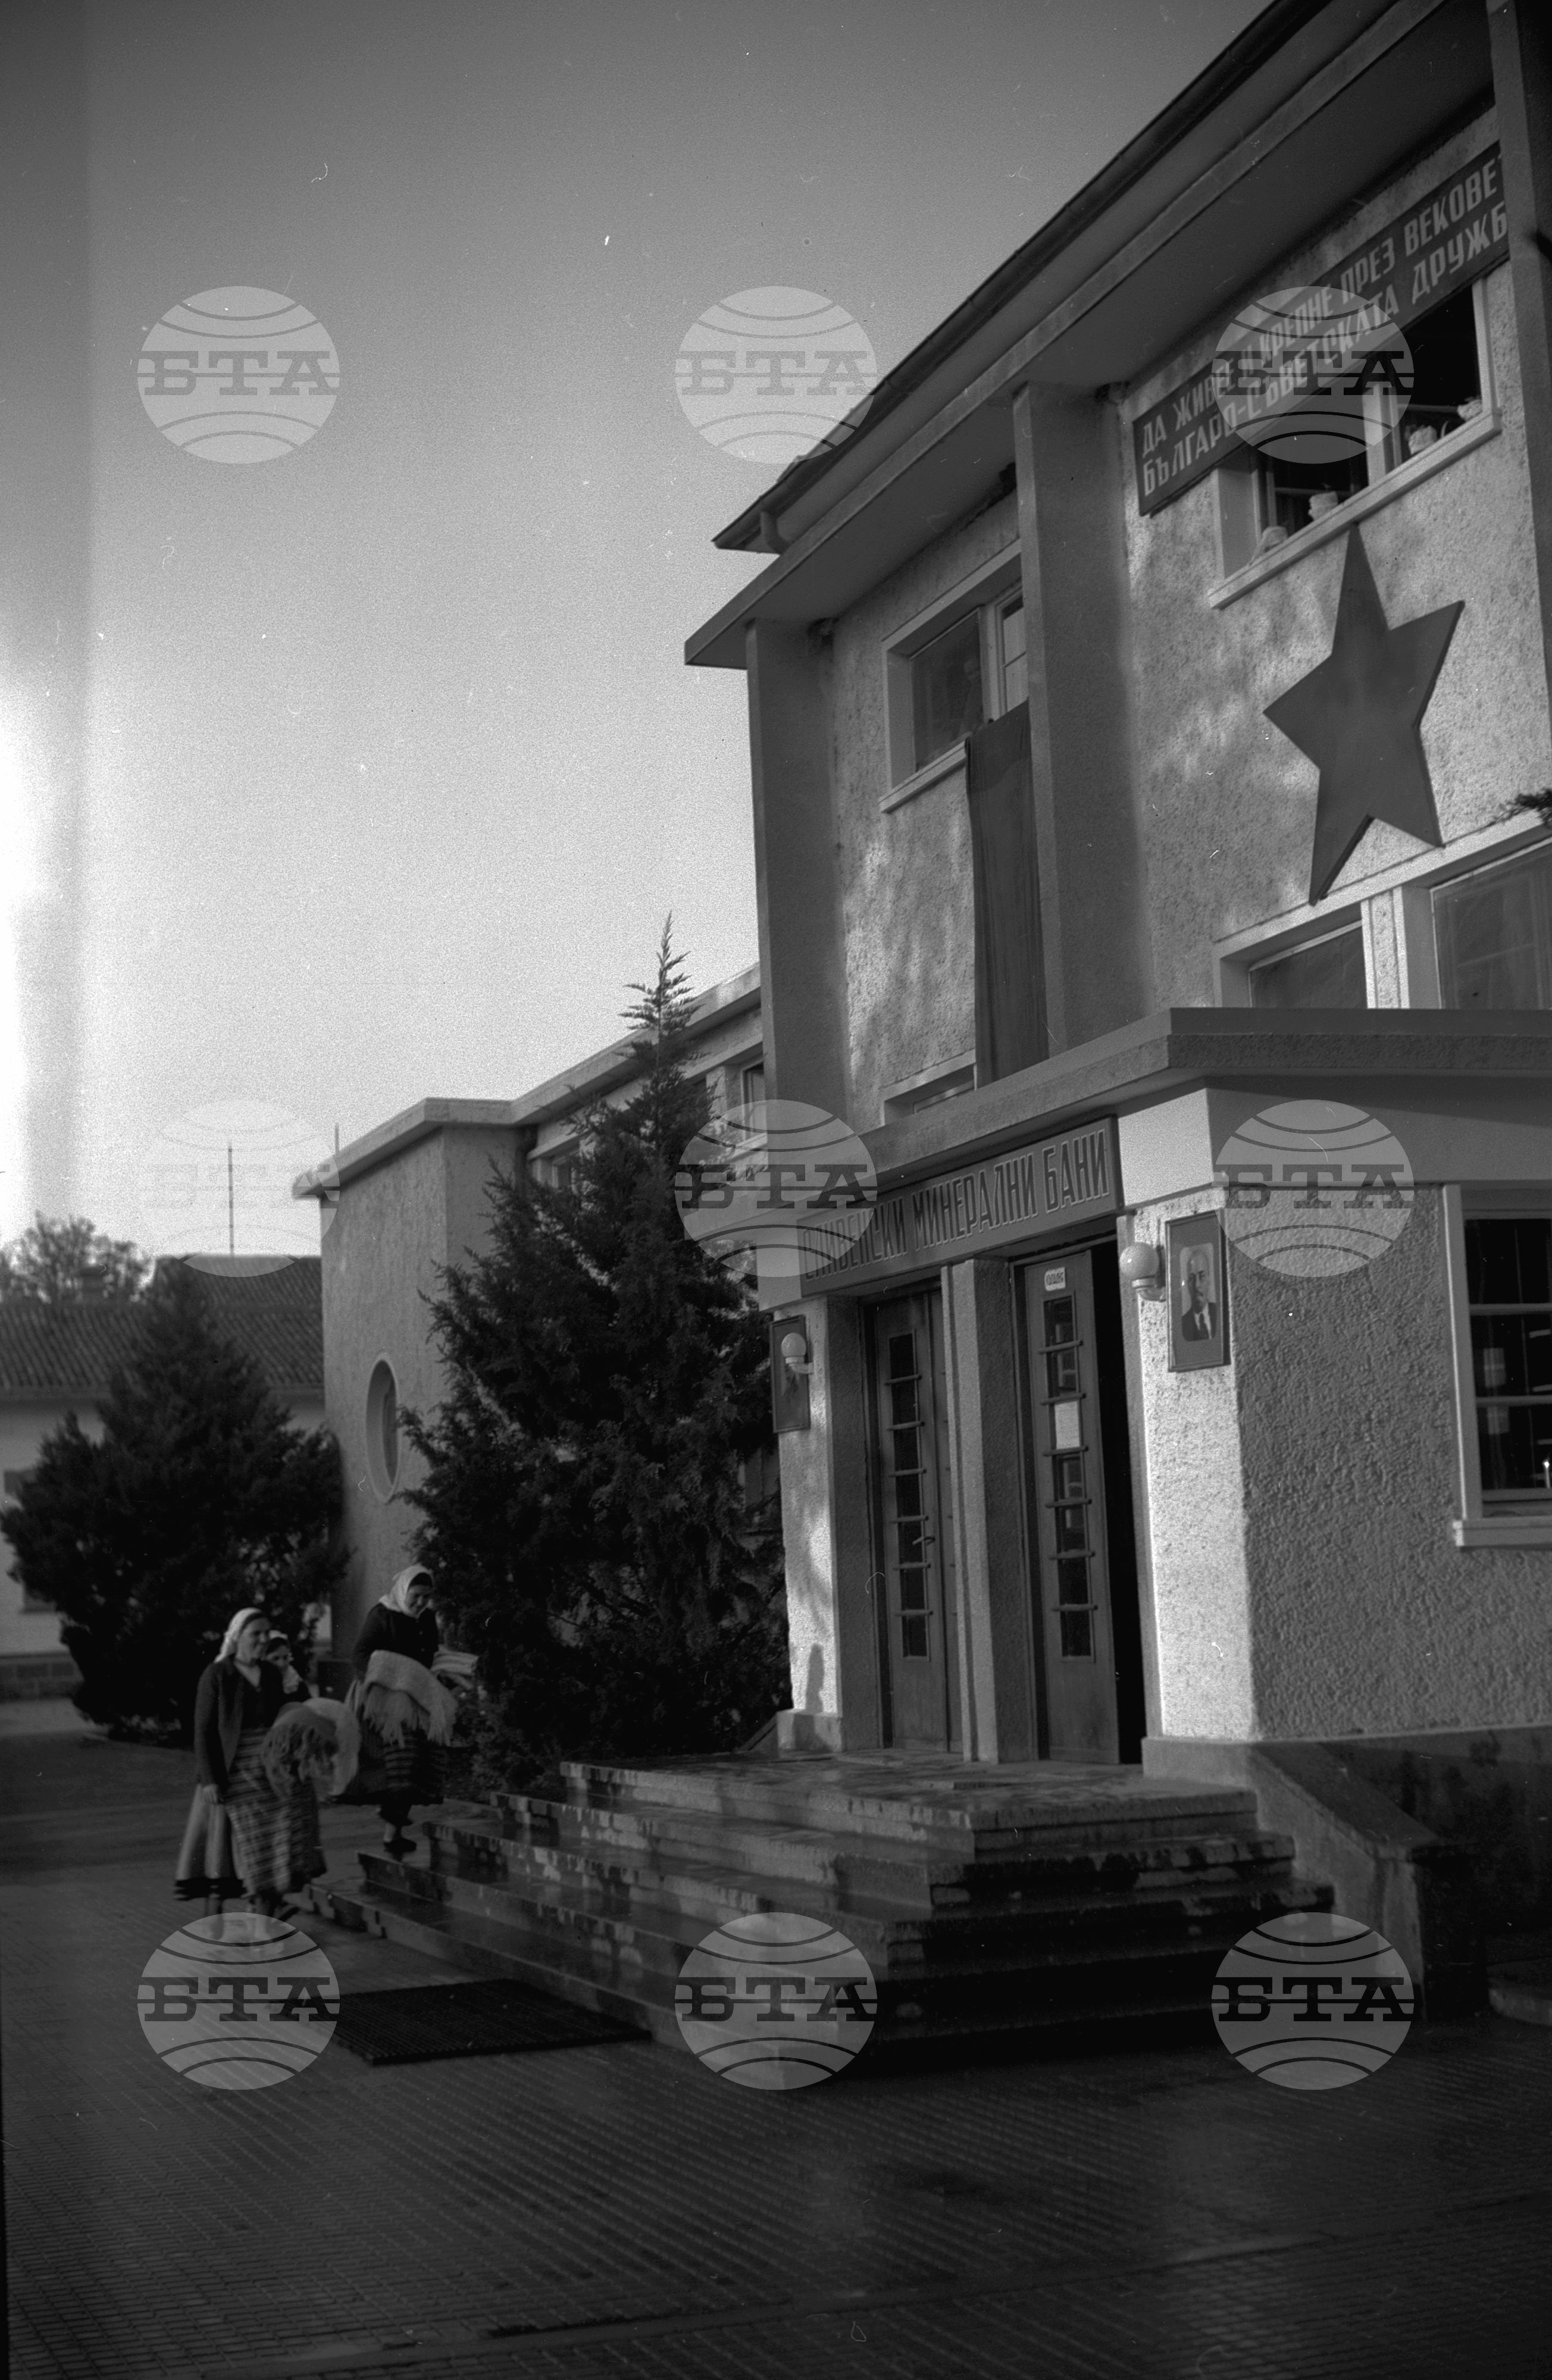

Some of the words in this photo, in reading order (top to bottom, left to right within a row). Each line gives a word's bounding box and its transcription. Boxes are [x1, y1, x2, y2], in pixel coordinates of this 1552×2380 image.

[1143, 415, 1166, 458] ДА
[1173, 358, 1235, 431] ЖИВЕЕ
[1241, 345, 1254, 380] И
[1259, 284, 1334, 365] КРЕПНЕ
[1341, 237, 1395, 305] ПРЕЗ
[1404, 153, 1501, 257] ВЕКОВЕ
[1143, 284, 1398, 497] БЪЛГАРО-СЪВЕТСКАТА
[803, 1195, 908, 1282] СЛИВЕНСКИ
[912, 1153, 1038, 1251] МИНЕРАЛНИ
[1042, 1129, 1109, 1213] БАНИ
